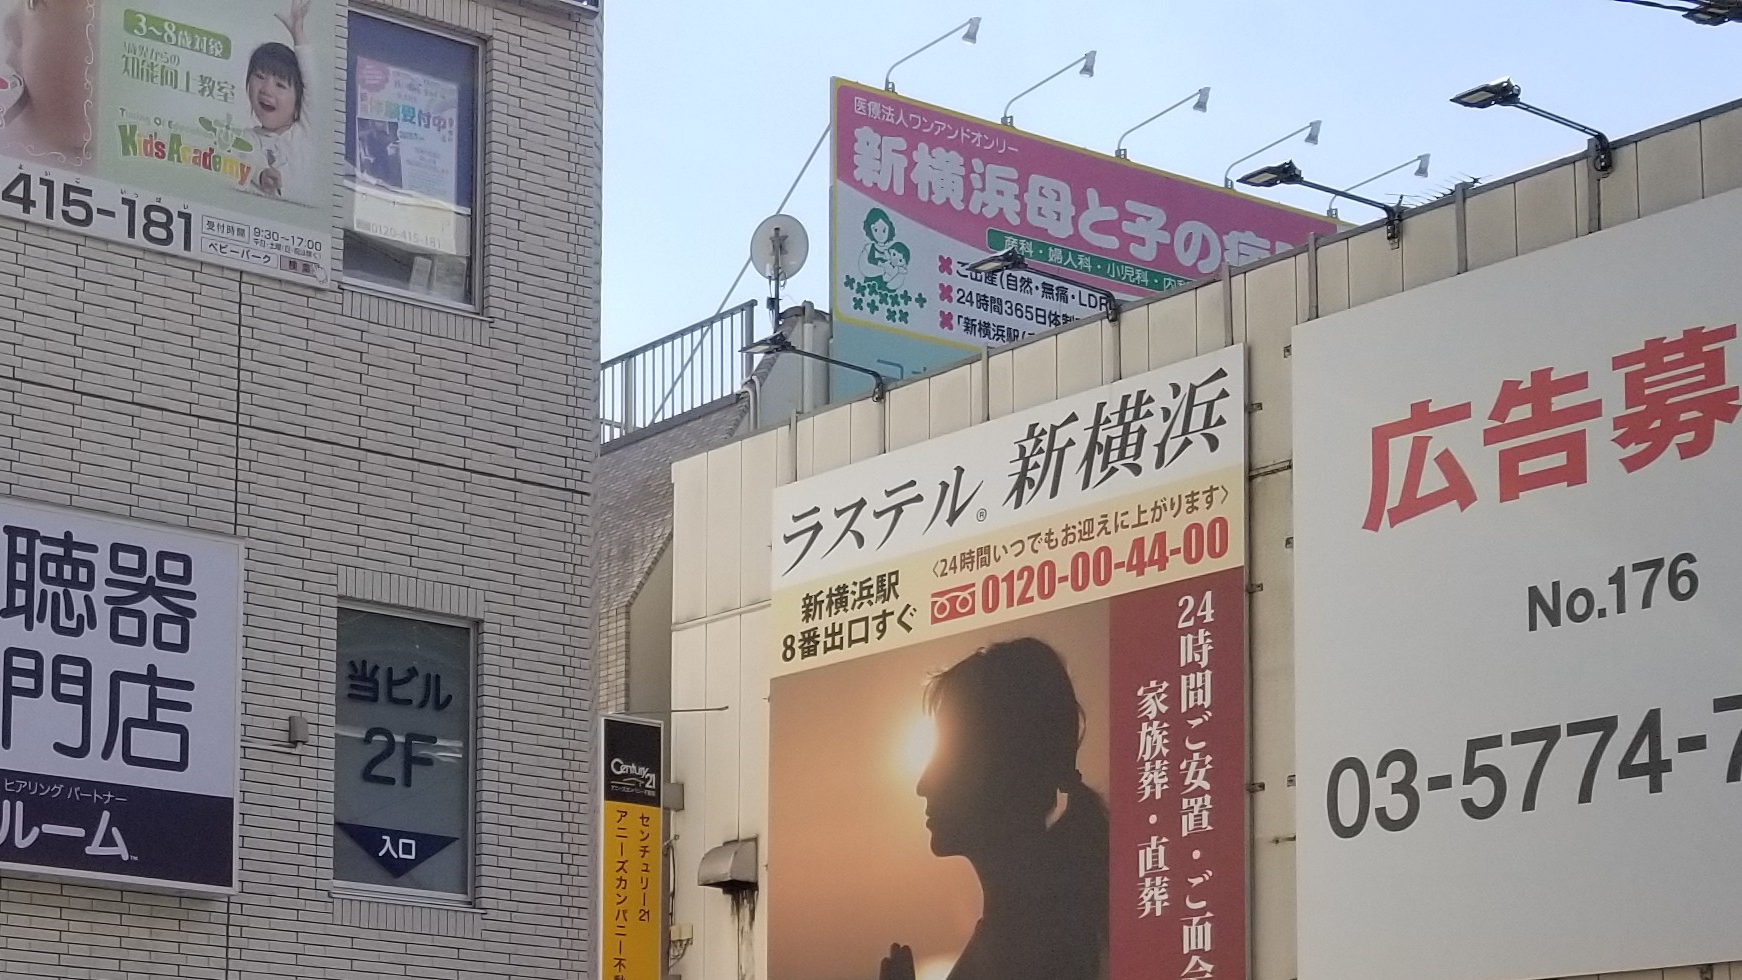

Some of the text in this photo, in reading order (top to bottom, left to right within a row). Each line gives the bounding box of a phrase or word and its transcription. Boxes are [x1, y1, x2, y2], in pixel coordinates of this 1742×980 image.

[854, 95, 1019, 155] 医療法人ワンアンドオンリー
[206, 220, 246, 239] 受付時間
[208, 242, 271, 264] ベビーパーク
[781, 367, 1231, 578] ラステル 新横浜
[981, 516, 1229, 615] 0120-00-44-00
[1527, 551, 1700, 632] No.176
[801, 569, 900, 624] 新横浜駅
[781, 602, 919, 663] 8番出口すぐ
[347, 659, 453, 711] 当ビル
[361, 726, 438, 788] 2F
[4, 778, 128, 804] ヒアリング パートナー
[1136, 678, 1171, 920] 家族葬・直葬
[378, 835, 417, 861] 入口
[638, 812, 651, 923] センチュリー21
